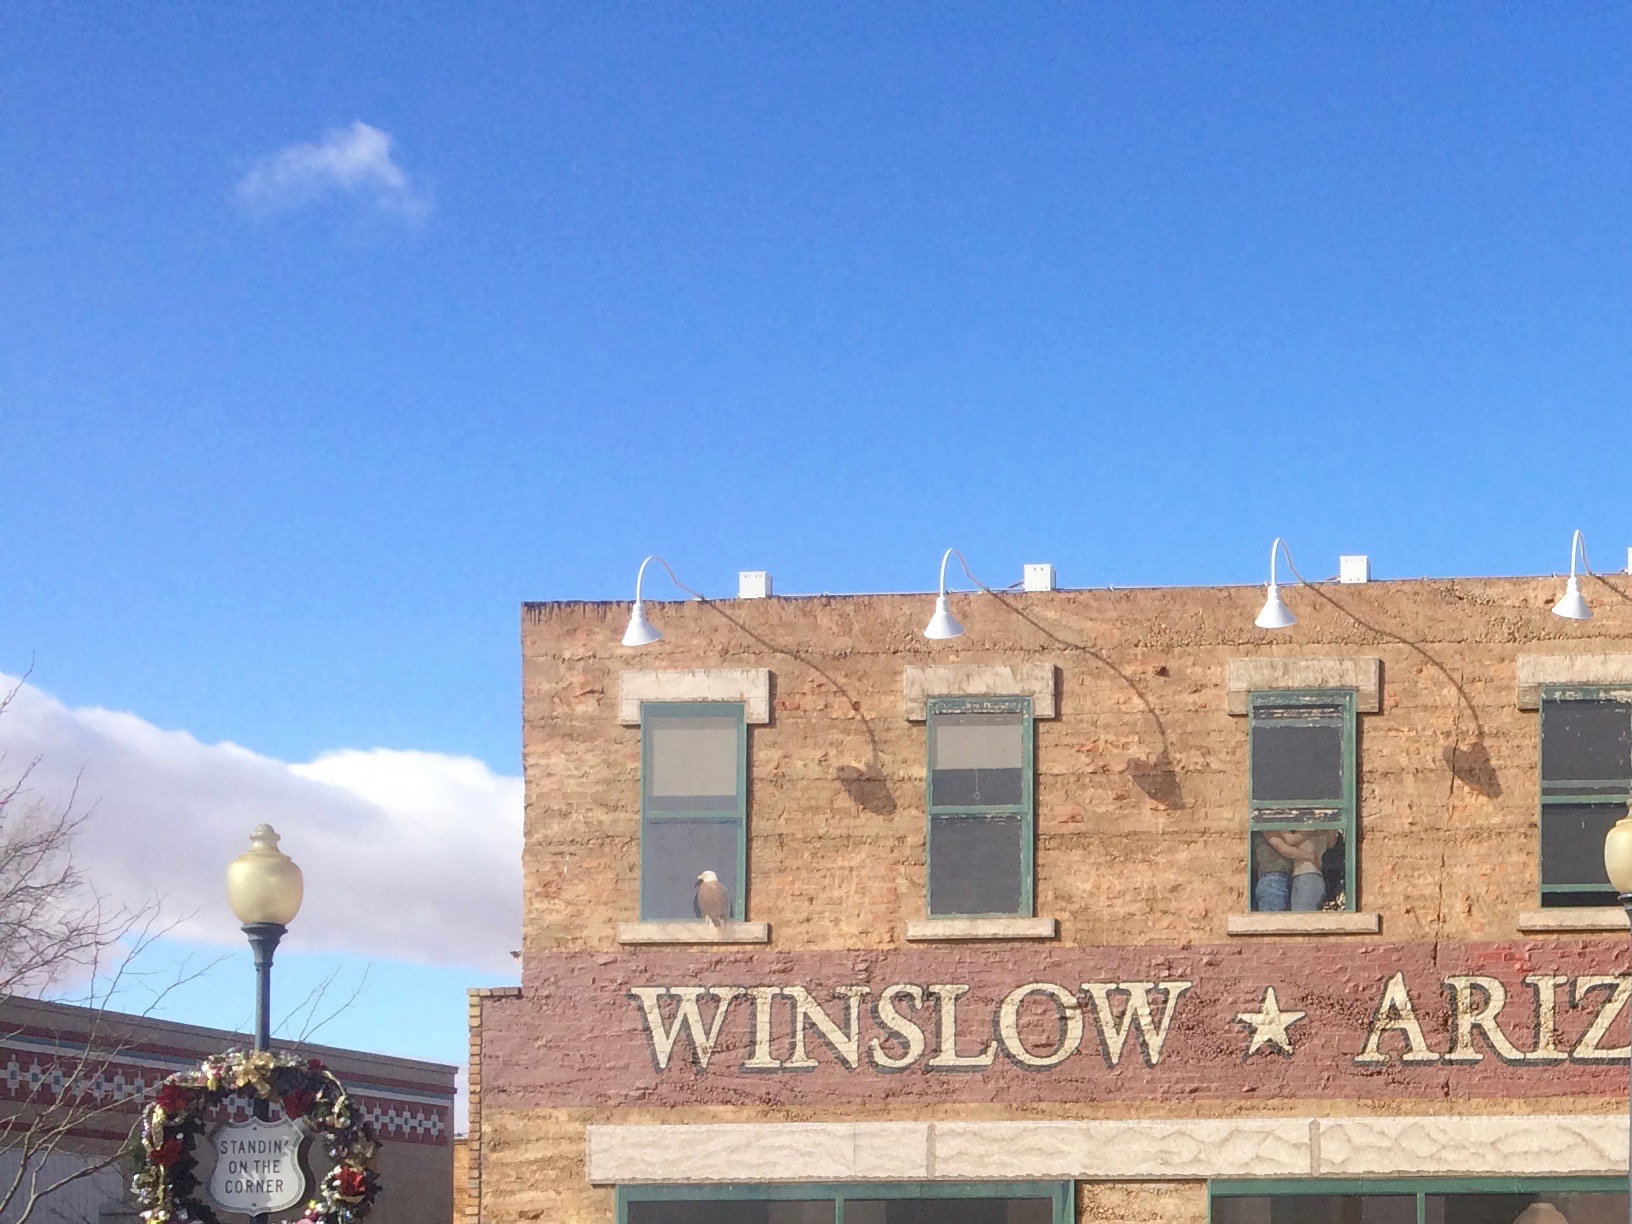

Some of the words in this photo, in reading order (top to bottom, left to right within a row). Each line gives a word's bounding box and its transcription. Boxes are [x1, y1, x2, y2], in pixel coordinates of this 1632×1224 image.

[627, 980, 1193, 1071] WINSLOW
[220, 1140, 290, 1154] STANDIN'
[228, 1160, 248, 1174] ON
[253, 1159, 280, 1174] THE
[225, 1180, 284, 1194] CORNER
